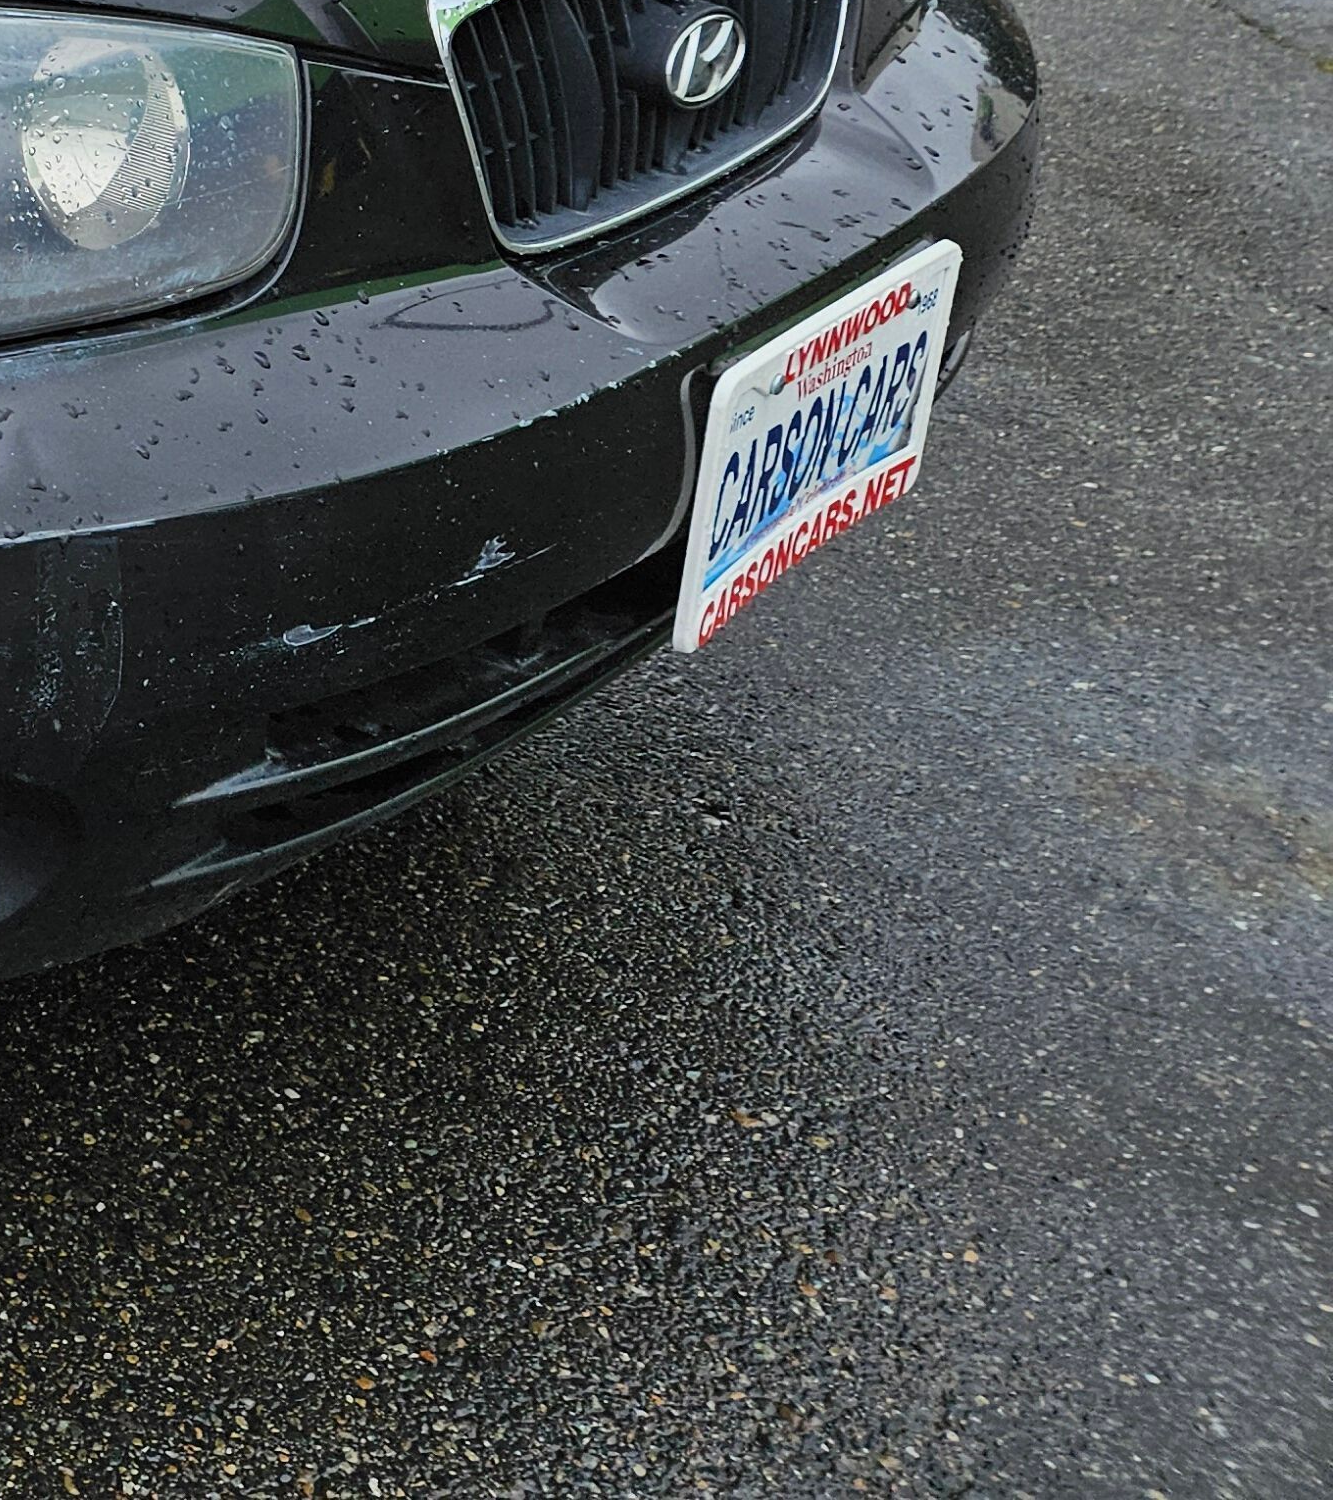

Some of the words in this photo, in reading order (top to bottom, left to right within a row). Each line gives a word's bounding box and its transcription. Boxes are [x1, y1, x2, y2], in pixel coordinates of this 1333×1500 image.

[783, 282, 912, 386] LYNNWOOD
[796, 341, 874, 401] Washington
[709, 379, 847, 562] CARSON
[837, 330, 928, 468] CARS
[698, 454, 918, 648] CARSONCARS.NET
